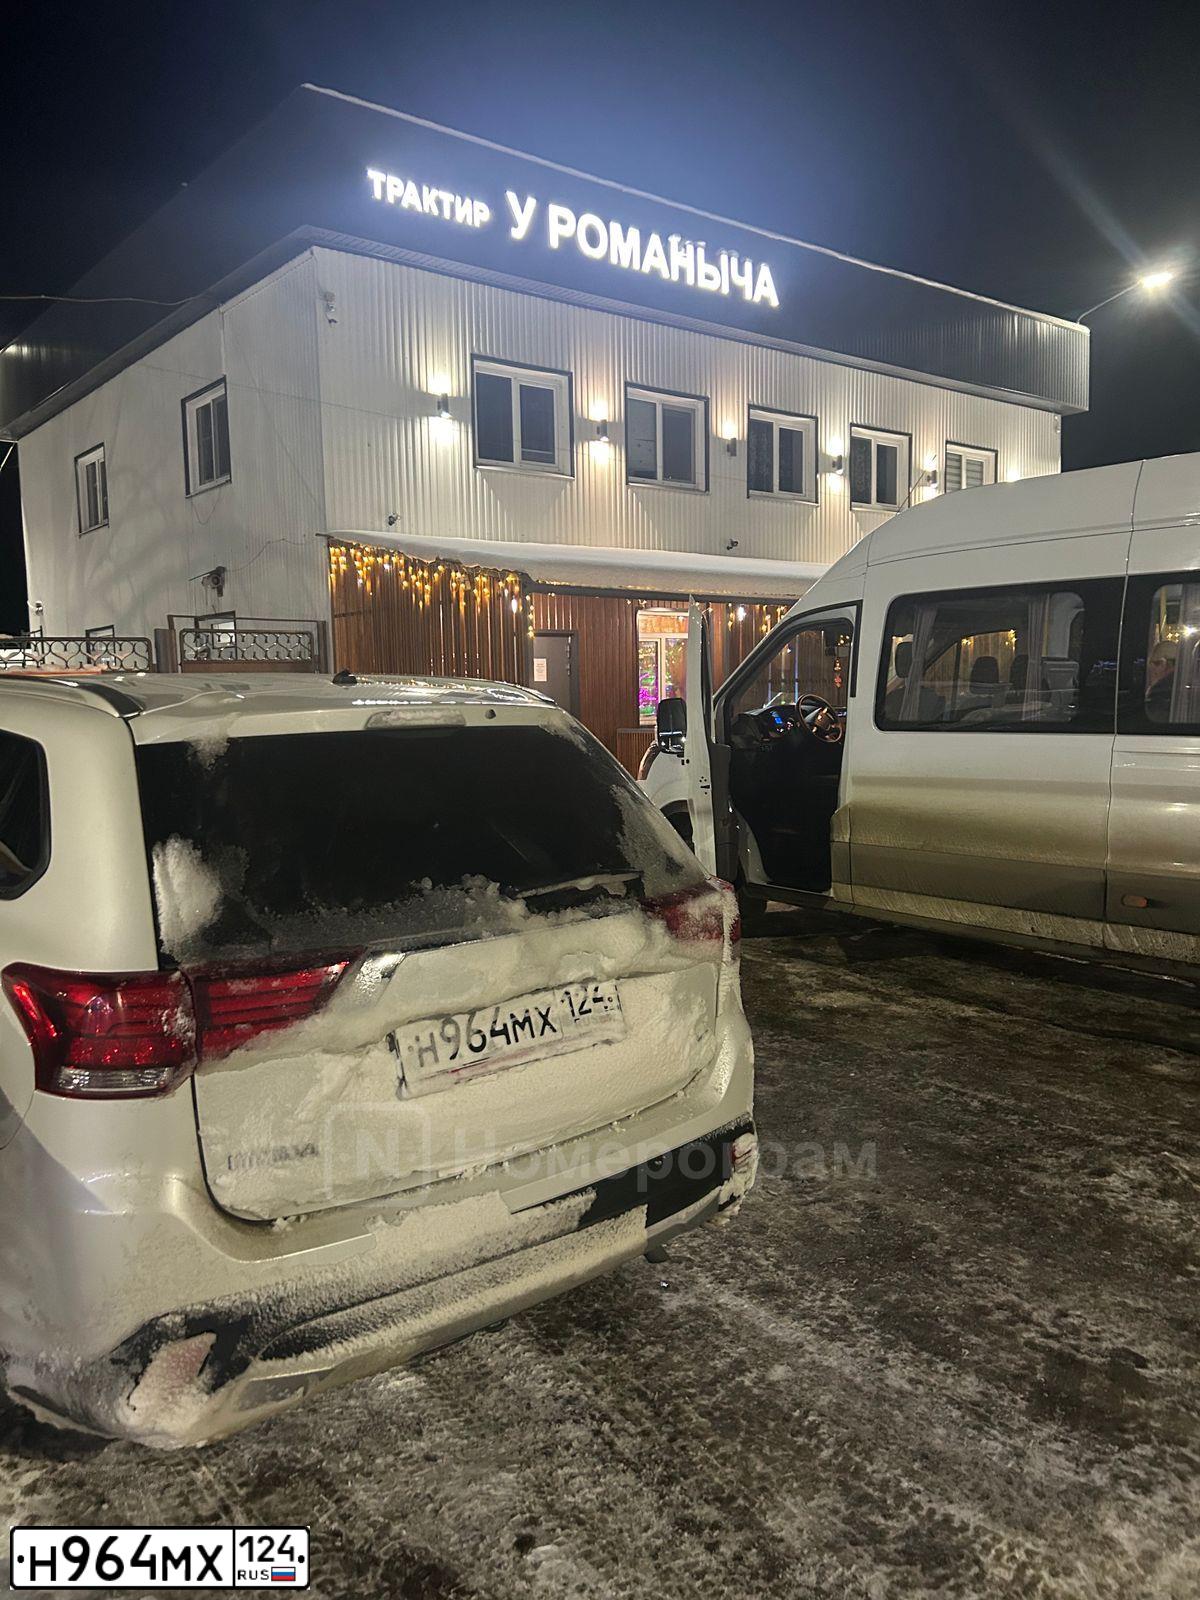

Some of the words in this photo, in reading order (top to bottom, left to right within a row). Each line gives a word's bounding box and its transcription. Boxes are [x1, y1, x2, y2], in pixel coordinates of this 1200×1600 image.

[367, 168, 491, 228] ТРАКТИР
[505, 190, 537, 240] У
[548, 203, 780, 308] РОМАНЫЧА
[415, 1006, 557, 1068] Н964МХ
